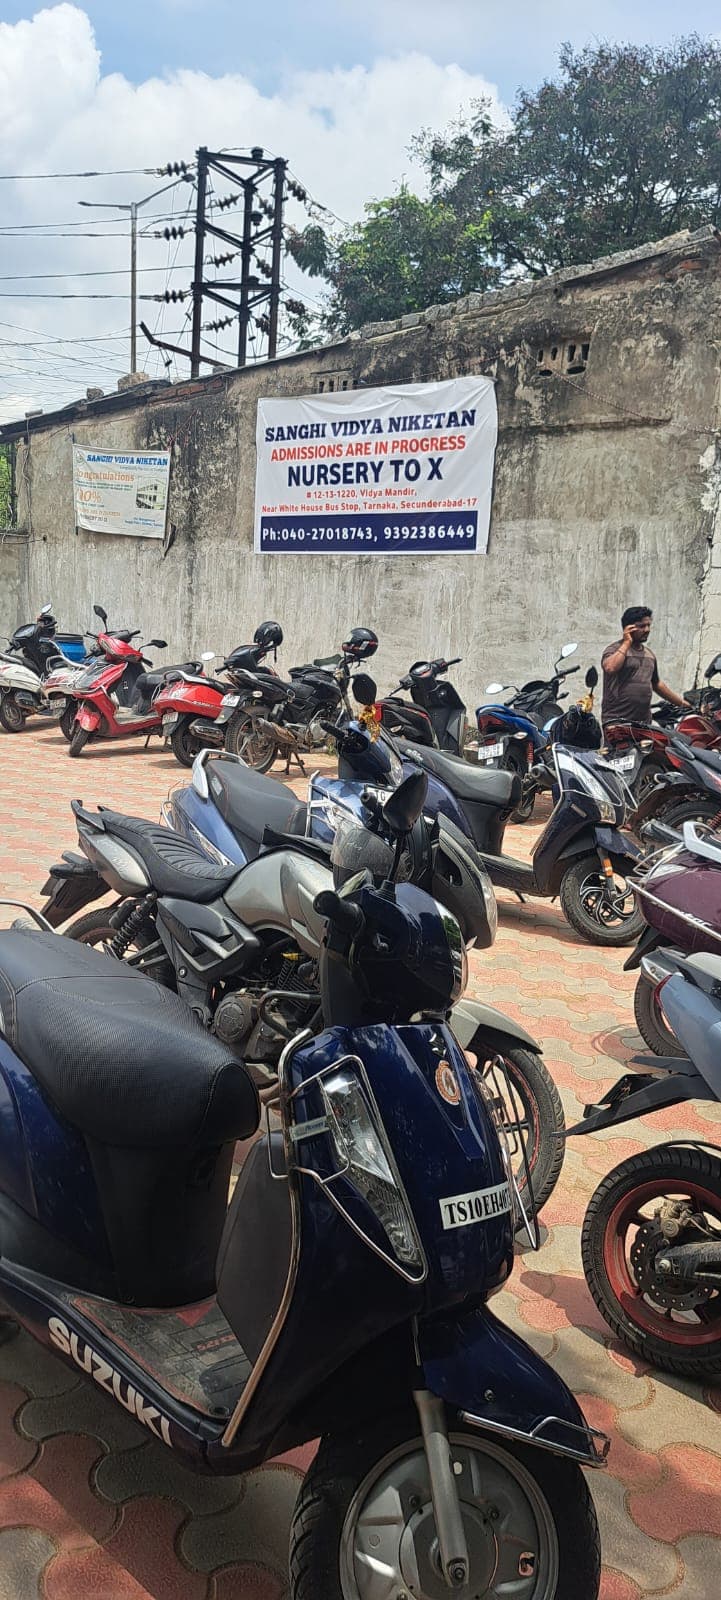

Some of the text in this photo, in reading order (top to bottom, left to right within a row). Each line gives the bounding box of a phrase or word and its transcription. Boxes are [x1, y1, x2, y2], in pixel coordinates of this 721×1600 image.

[264, 409, 476, 443] SANGHI VIDYA NIKETAN
[87, 454, 169, 466] SANGHI VIDYA NIKETAN
[271, 435, 466, 462] ADMISSIONS ARE IN PROGRESS
[287, 457, 444, 487] NURSERY TO X
[279, 504, 298, 512] White
[301, 502, 323, 511] House
[325, 502, 339, 511] Bus
[341, 501, 361, 512] Stop,
[363, 501, 399, 510] Tarnaka,
[400, 497, 478, 510] Secunderabad-17
[314, 489, 358, 499] 12-13-1220,
[360, 488, 383, 498] Vidya
[385, 487, 417, 497] Mandir,
[262, 524, 475, 543] Ph:040-27018743, 9392386449
[48, 1316, 174, 1448] SUZUKI
